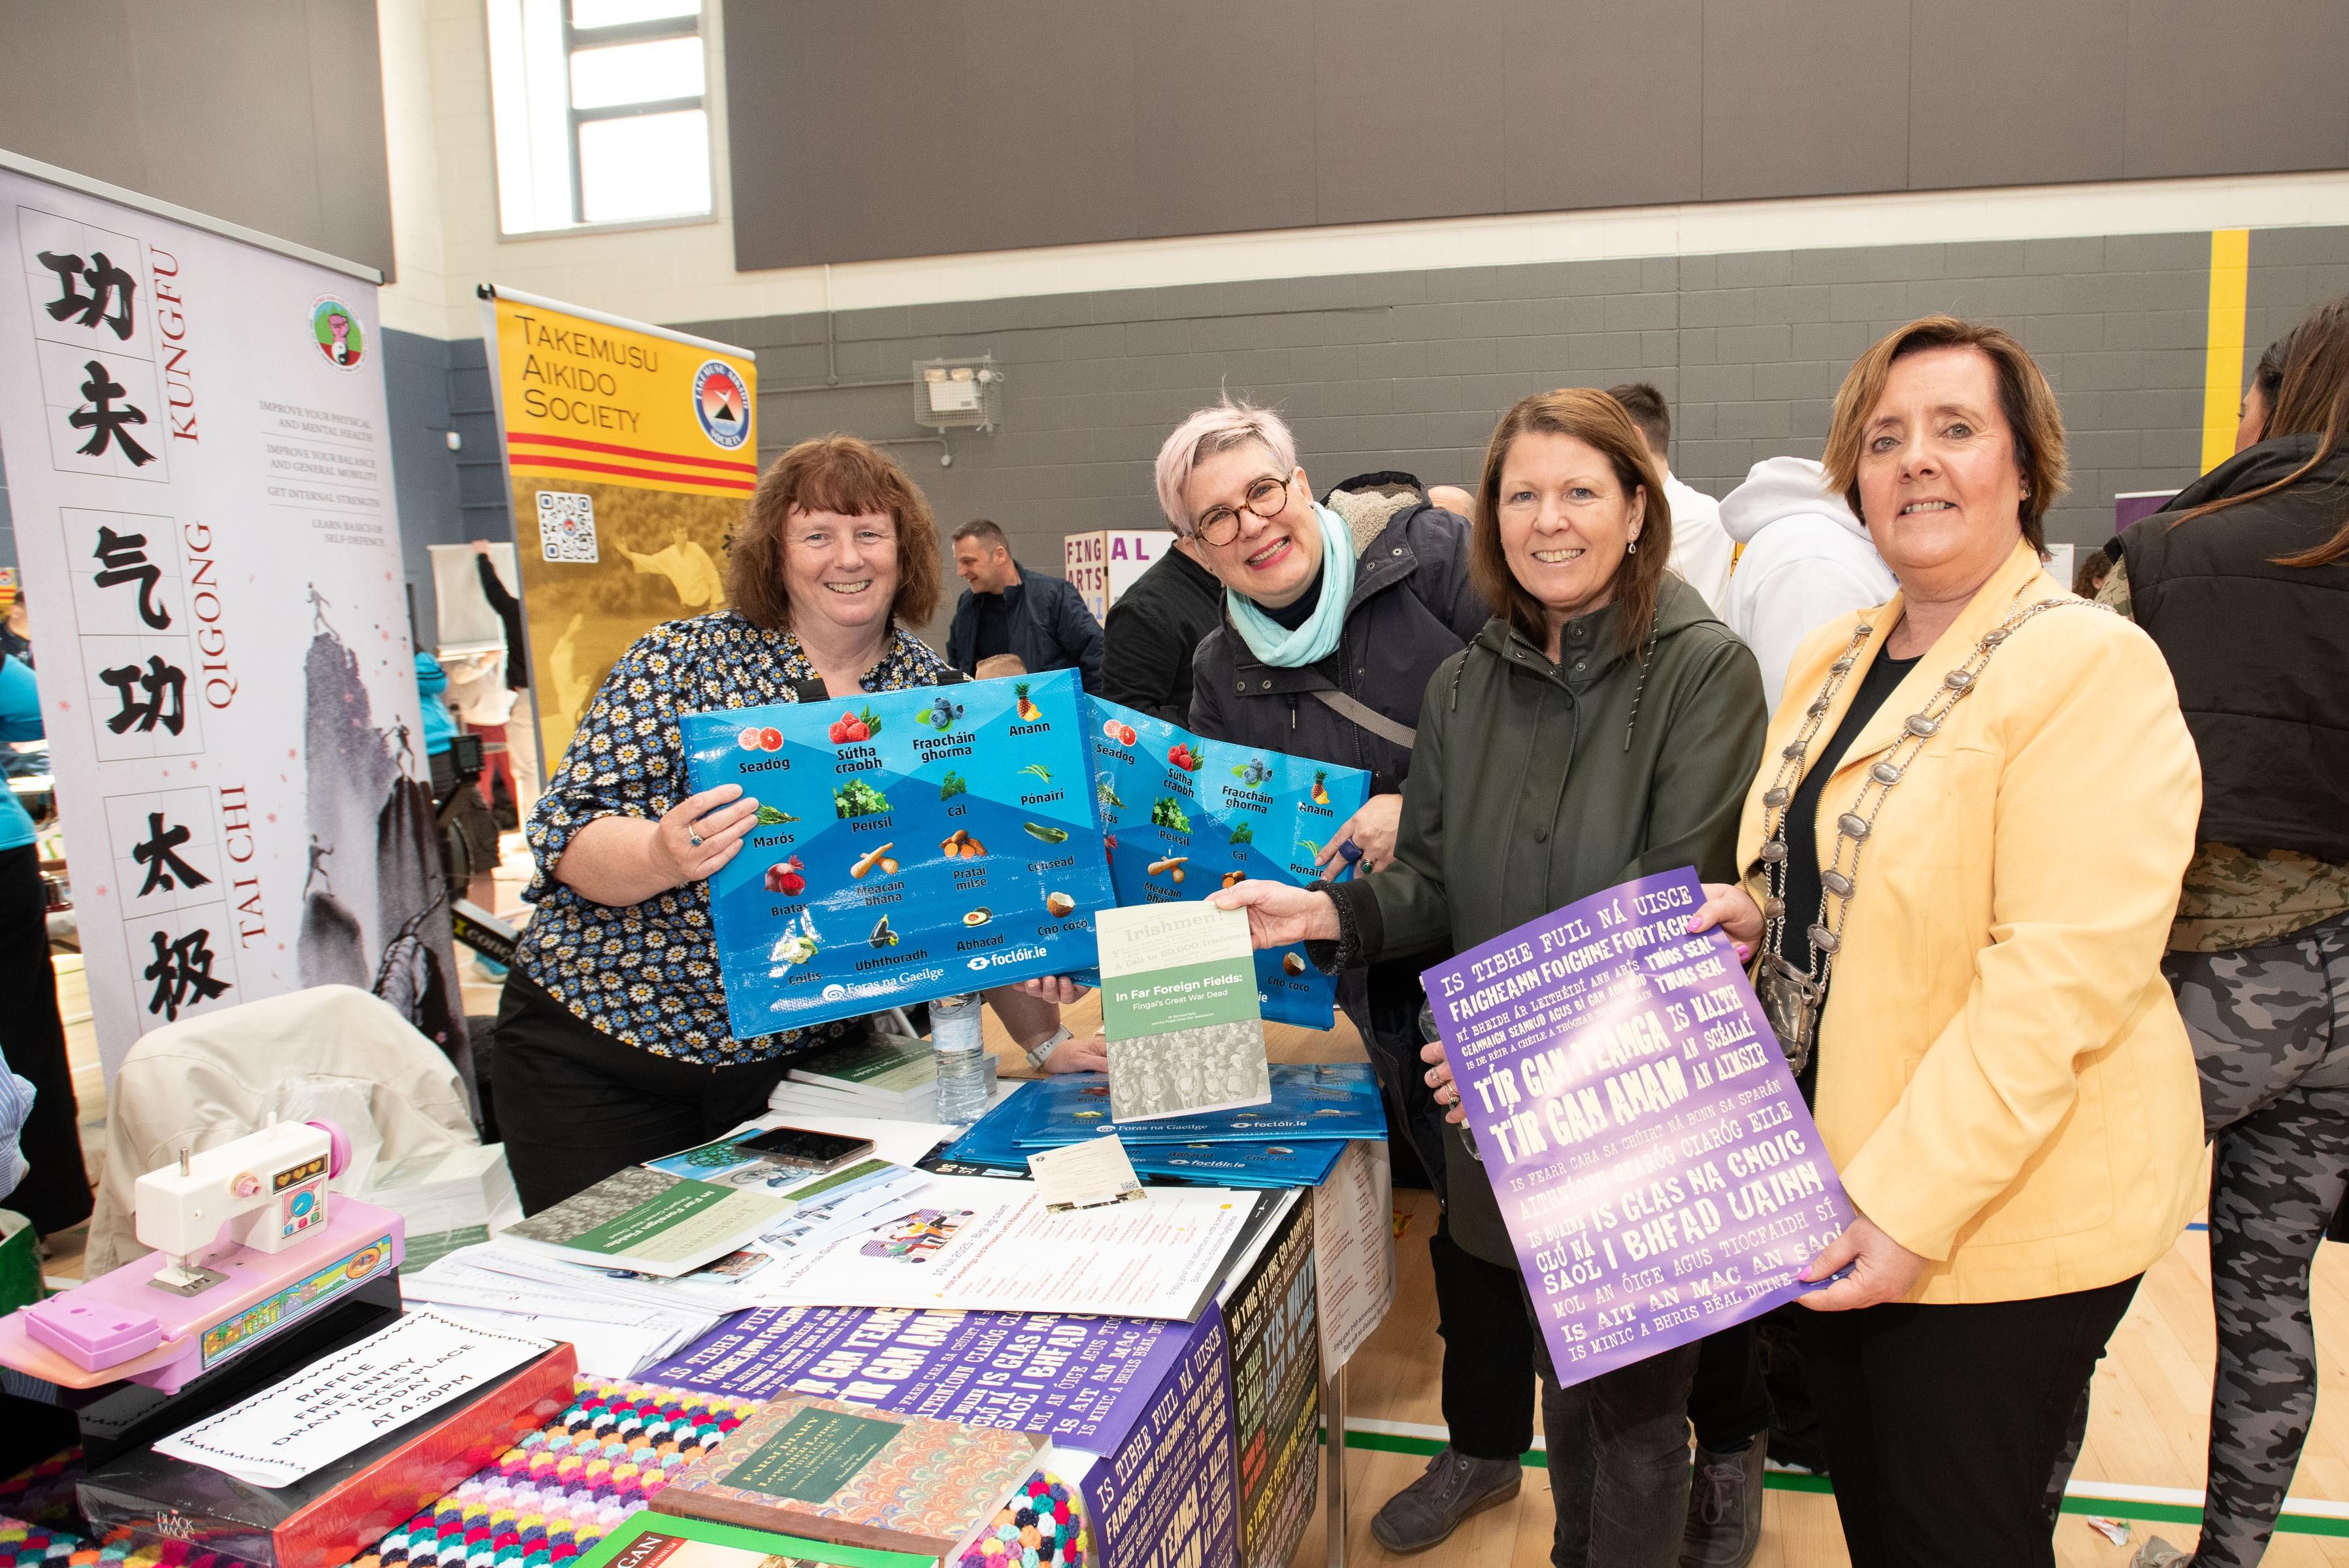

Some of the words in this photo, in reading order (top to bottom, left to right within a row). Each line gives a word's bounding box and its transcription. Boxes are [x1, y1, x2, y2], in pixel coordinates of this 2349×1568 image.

[150, 244, 199, 444] KUNGFU
[514, 314, 659, 372] TAKEMUSU
[521, 354, 616, 397] AIKIDO
[259, 400, 303, 416] IMPROVE
[304, 408, 328, 420] YOUR
[331, 414, 371, 428] PHYSICAL
[523, 389, 640, 434] SOCIETY
[278, 419, 300, 429] AND
[302, 422, 338, 436] MENTAL
[340, 429, 373, 441] HEALTH
[267, 444, 310, 459] IMPROVE
[312, 450, 337, 462] YOUR
[338, 455, 376, 468] BALANCE
[271, 459, 291, 470] AND
[293, 462, 335, 475] GENERAL
[337, 470, 378, 482] MOBILITY
[267, 487, 286, 497] GET
[288, 489, 335, 502] INTERNAL
[337, 495, 381, 508] STRENGTH
[312, 519, 343, 530] LEARN
[1067, 538, 1102, 564] FING
[1111, 538, 1149, 560] AL
[1068, 567, 1102, 591] ARTS
[185, 521, 238, 709] QIGONG
[913, 732, 976, 750] Fraocháin
[1009, 723, 1051, 736] Anann
[739, 757, 790, 774] Seadóg
[835, 757, 882, 774] craobh
[837, 746, 876, 760] Sútha
[921, 746, 972, 763] ghorma
[1096, 743, 1134, 765] Seadóg
[1163, 779, 1194, 798] craobh
[1168, 768, 1192, 786] Sútha
[1021, 788, 1064, 806] Pónairí
[1223, 785, 1273, 804] Fraocháin
[1226, 797, 1267, 813] ghorma
[947, 804, 967, 817] Cál
[1299, 802, 1333, 817] Anann
[220, 784, 254, 864] CHI
[852, 816, 893, 832] Peirsil
[753, 832, 795, 848] Marós
[1160, 830, 1189, 847] Peirsil
[1232, 851, 1247, 861] Cál
[953, 864, 986, 879] Prátaí
[1290, 863, 1324, 877] Pónair
[956, 878, 987, 890] milse
[1144, 882, 1181, 898] Meacain
[771, 904, 808, 916] Biatas
[865, 892, 902, 906] bhána
[238, 875, 265, 949] TAI
[1038, 923, 1059, 936] Cnó
[1063, 917, 1088, 931] cócó
[957, 934, 1004, 952] Abhacád
[1441, 972, 1465, 997] IS
[1471, 942, 1534, 983] TIBHE
[1539, 919, 1592, 954] FUIL
[1597, 898, 1627, 929] NÁ
[1634, 885, 1693, 916] UISCE
[855, 949, 928, 972] Ubhthoradh
[991, 945, 1047, 966] foclóir.ie
[1126, 958, 1144, 968] Call
[1645, 947, 1684, 972] THÍOS
[1683, 936, 1716, 958] SEAL
[789, 971, 821, 985] Cóilis
[847, 980, 881, 994] Foras
[883, 979, 896, 987] na
[899, 968, 944, 985] Gaeilge
[1449, 968, 1542, 1022] FAIGHEANN
[1540, 939, 1614, 983] FOIGHNE
[1611, 915, 1696, 954] FORTACH
[1116, 992, 1127, 1002] In
[1132, 988, 1150, 1000] Far
[1154, 981, 1200, 996] Foreign
[1204, 973, 1243, 987] Fields:
[1267, 976, 1285, 990] Cnó
[1288, 980, 1309, 992] cócó
[1133, 1000, 1163, 1011] Fingal's
[1165, 995, 1187, 1005] Great
[1207, 989, 1228, 998] Dead
[1471, 1012, 1511, 1036] BHEIDH
[1530, 977, 1587, 1013] LEITHÉIDÍ
[1590, 972, 1611, 988] ANN
[1614, 958, 1641, 976] ARÍS
[1690, 984, 1743, 1023] MAITH
[1704, 1011, 1756, 1051] SCÉALAÍ
[1473, 1063, 1521, 1113] TÍR
[1520, 1047, 1568, 1098] GAN
[1570, 1010, 1671, 1076] TEANGA
[1715, 1042, 1769, 1081] AIMSIR
[1545, 1086, 1609, 1147] GAN
[1604, 1055, 1689, 1126] ANAM
[1738, 1079, 1782, 1106] SPARÁN
[1167, 1123, 1207, 1132] Gaeilge
[1254, 1120, 1307, 1128] foclóir.ie
[1680, 1117, 1744, 1158] CIARÓG
[1747, 1101, 1794, 1133] EILE
[1621, 1176, 1685, 1222] GLAS
[1727, 1130, 1805, 1178] CNOIC
[1621, 1198, 1722, 1262] BHFAD
[1726, 1160, 1825, 1221] UAINN
[1622, 1266, 1664, 1294] ÓIGE
[1718, 1211, 1809, 1258] TIOCFAIDH
[1287, 1247, 1315, 1332] MAITH
[1543, 1259, 1603, 1295] SAOL
[1597, 1303, 1637, 1330] AIT
[1690, 1266, 1742, 1299] MAC
[1590, 1327, 1634, 1354] MINIC
[1652, 1305, 1700, 1331] BHRIS
[1702, 1293, 1743, 1315] BÉAL
[1746, 1272, 1792, 1299] DUINE
[1234, 1310, 1263, 1361] LABHAIR
[685, 1334, 746, 1365] TIBHE
[992, 1335, 1042, 1369] GLAS
[1021, 1325, 1089, 1378] BHFAD
[1194, 1324, 1221, 1373] UISCE
[295, 1364, 376, 1403] RAFFLE
[1068, 1387, 1101, 1413] AIT
[1108, 1331, 1141, 1362] MAC
[272, 1410, 341, 1446] DRAW
[342, 1377, 410, 1409] TAKES
[410, 1344, 476, 1375] PLACE
[293, 1392, 351, 1420] FREE
[351, 1358, 416, 1392] ENTRY
[361, 1377, 431, 1411] TODAY
[371, 1412, 395, 1428] AT
[401, 1374, 473, 1413] 4.30PM
[742, 1450, 782, 1482] FARM
[779, 1416, 819, 1450] DIARY
[785, 1445, 798, 1456] OF
[1115, 1425, 1151, 1486] TIBHE
[157, 1511, 194, 1531] BLACK
[157, 1524, 195, 1542] MAGIC
[648, 1542, 678, 1568] LENNIUM
